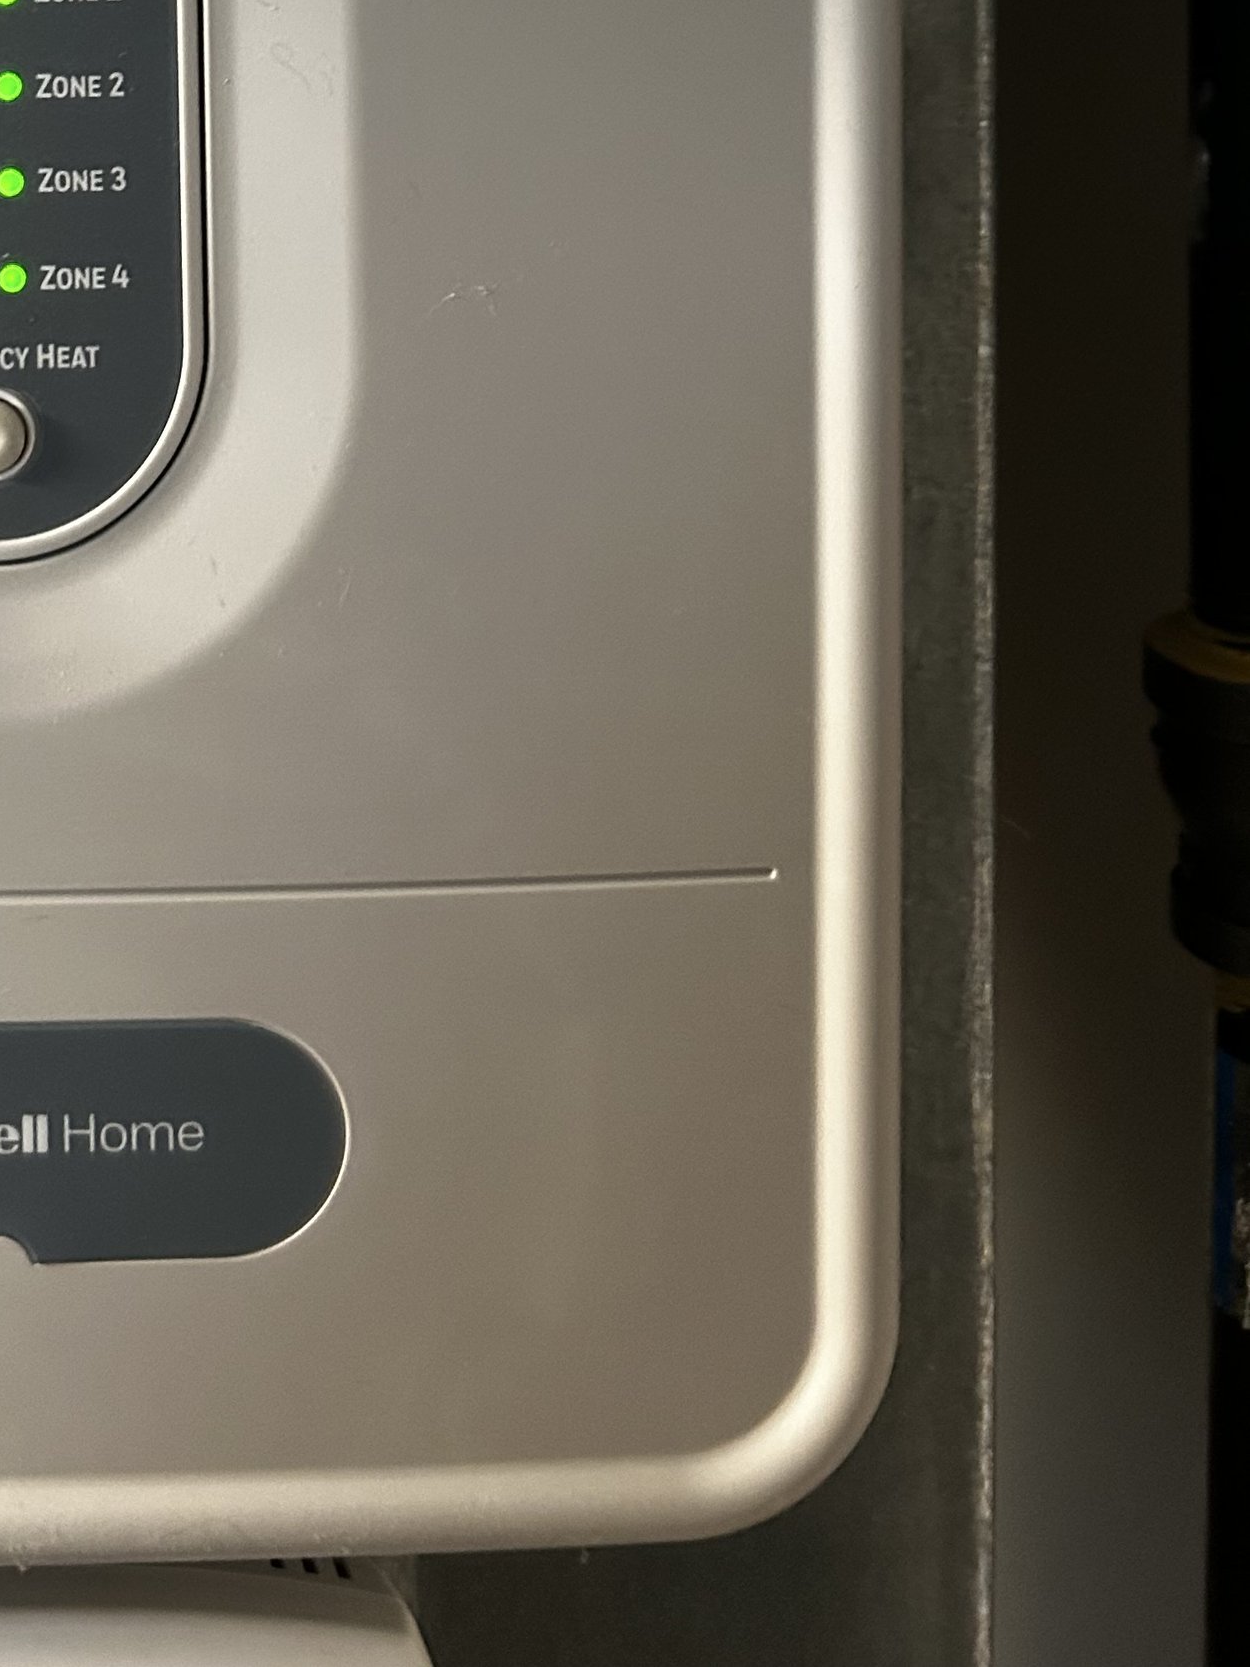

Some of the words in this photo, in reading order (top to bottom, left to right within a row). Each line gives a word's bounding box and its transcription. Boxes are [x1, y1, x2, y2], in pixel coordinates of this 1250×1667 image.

[35, 73, 102, 99] ZONE
[108, 71, 125, 97] 2
[37, 167, 104, 193] ZONE
[110, 166, 127, 192] 3
[39, 264, 106, 291] ZONE
[111, 263, 130, 289] 4
[36, 343, 100, 369] HEAT
[63, 1113, 205, 1153] Home
